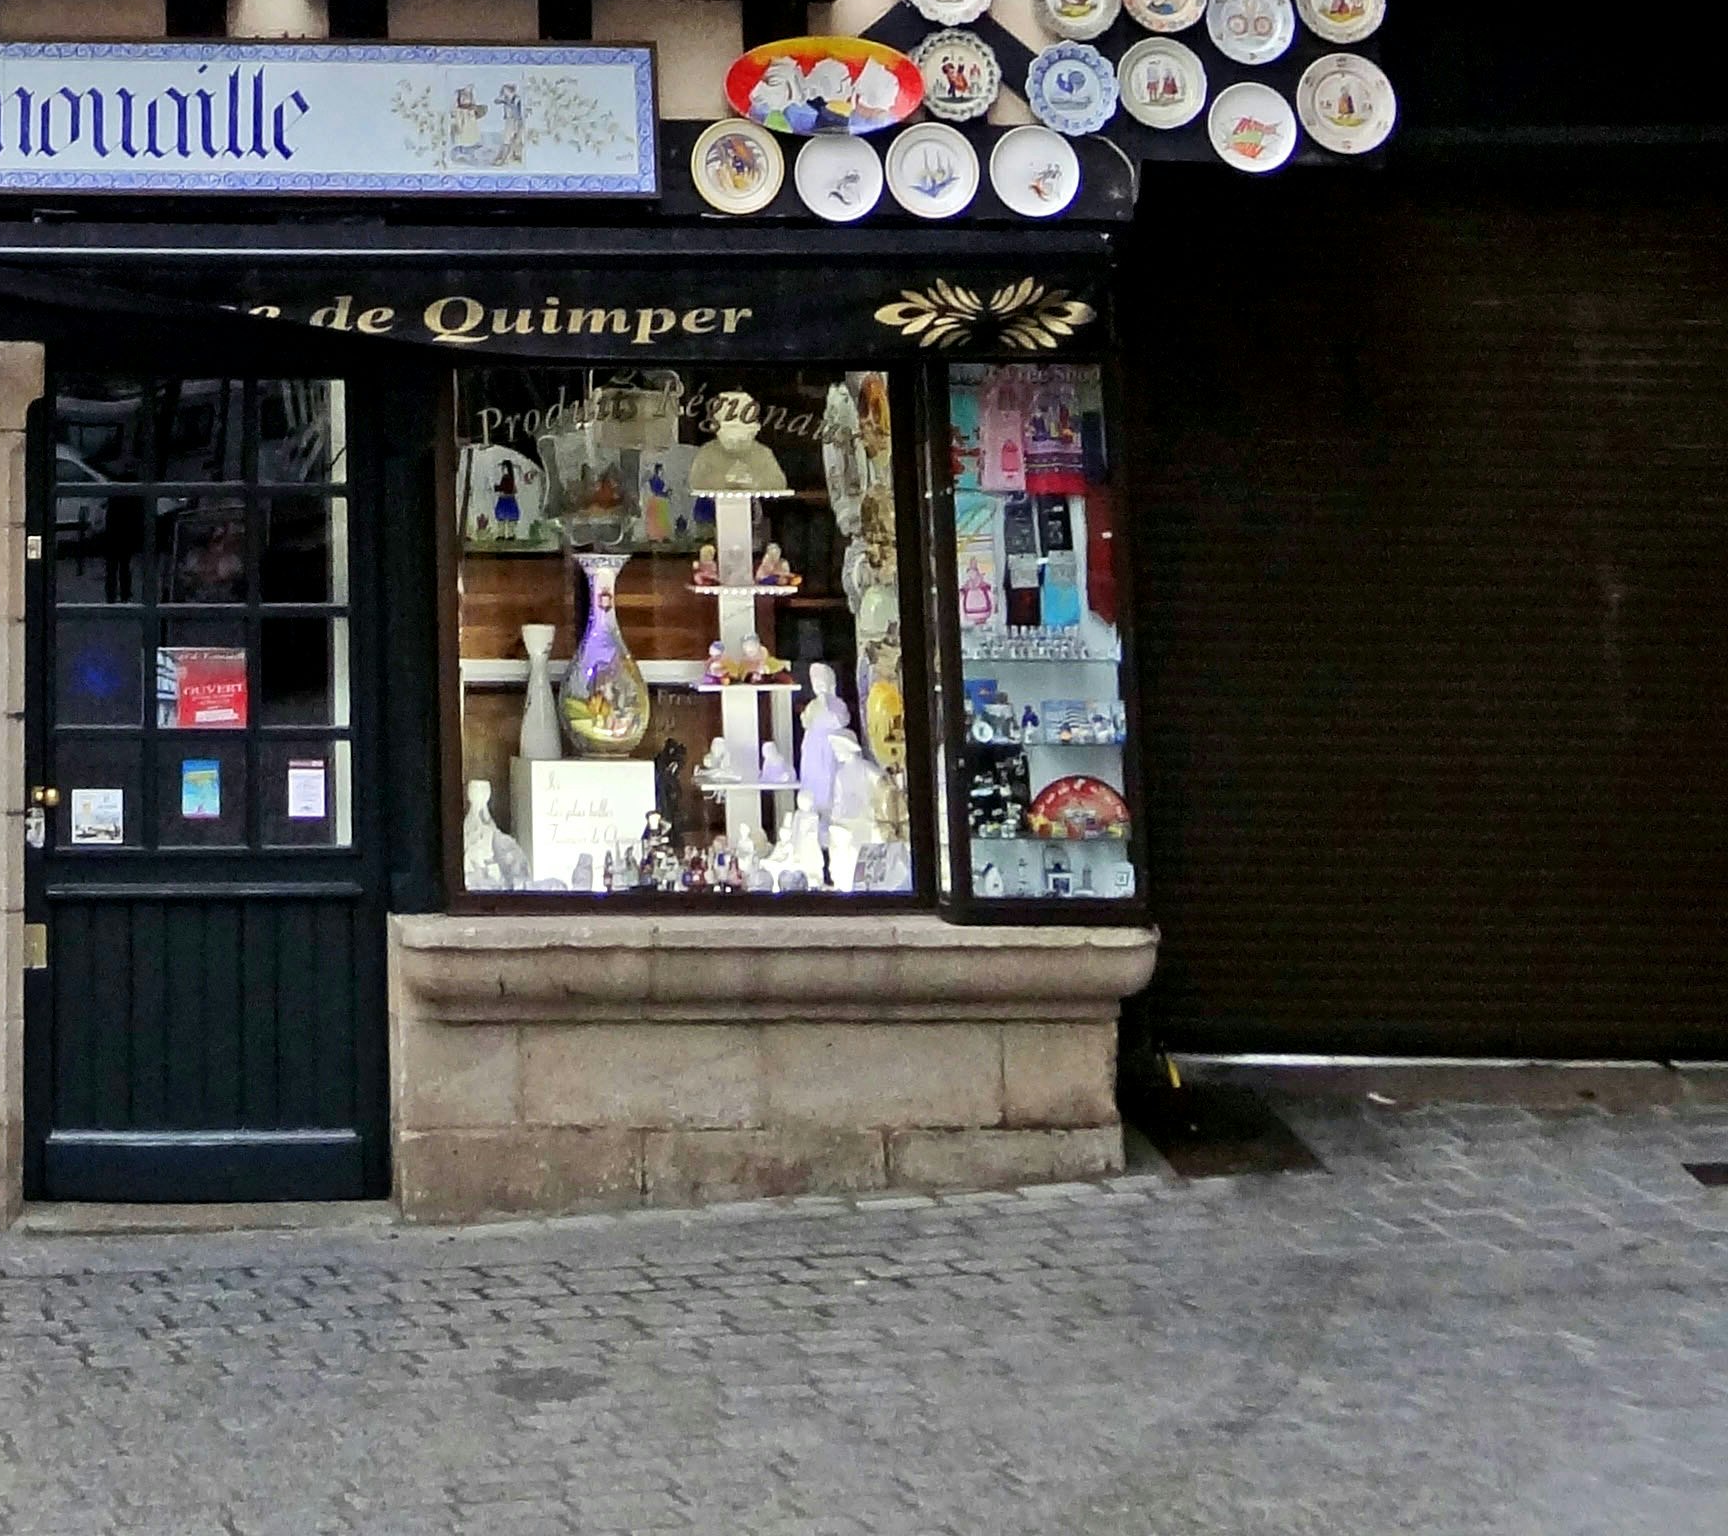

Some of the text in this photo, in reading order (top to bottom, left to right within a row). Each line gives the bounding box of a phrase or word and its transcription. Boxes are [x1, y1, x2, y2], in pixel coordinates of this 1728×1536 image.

[309, 295, 753, 344] de Quimper
[477, 386, 639, 446] Produits
